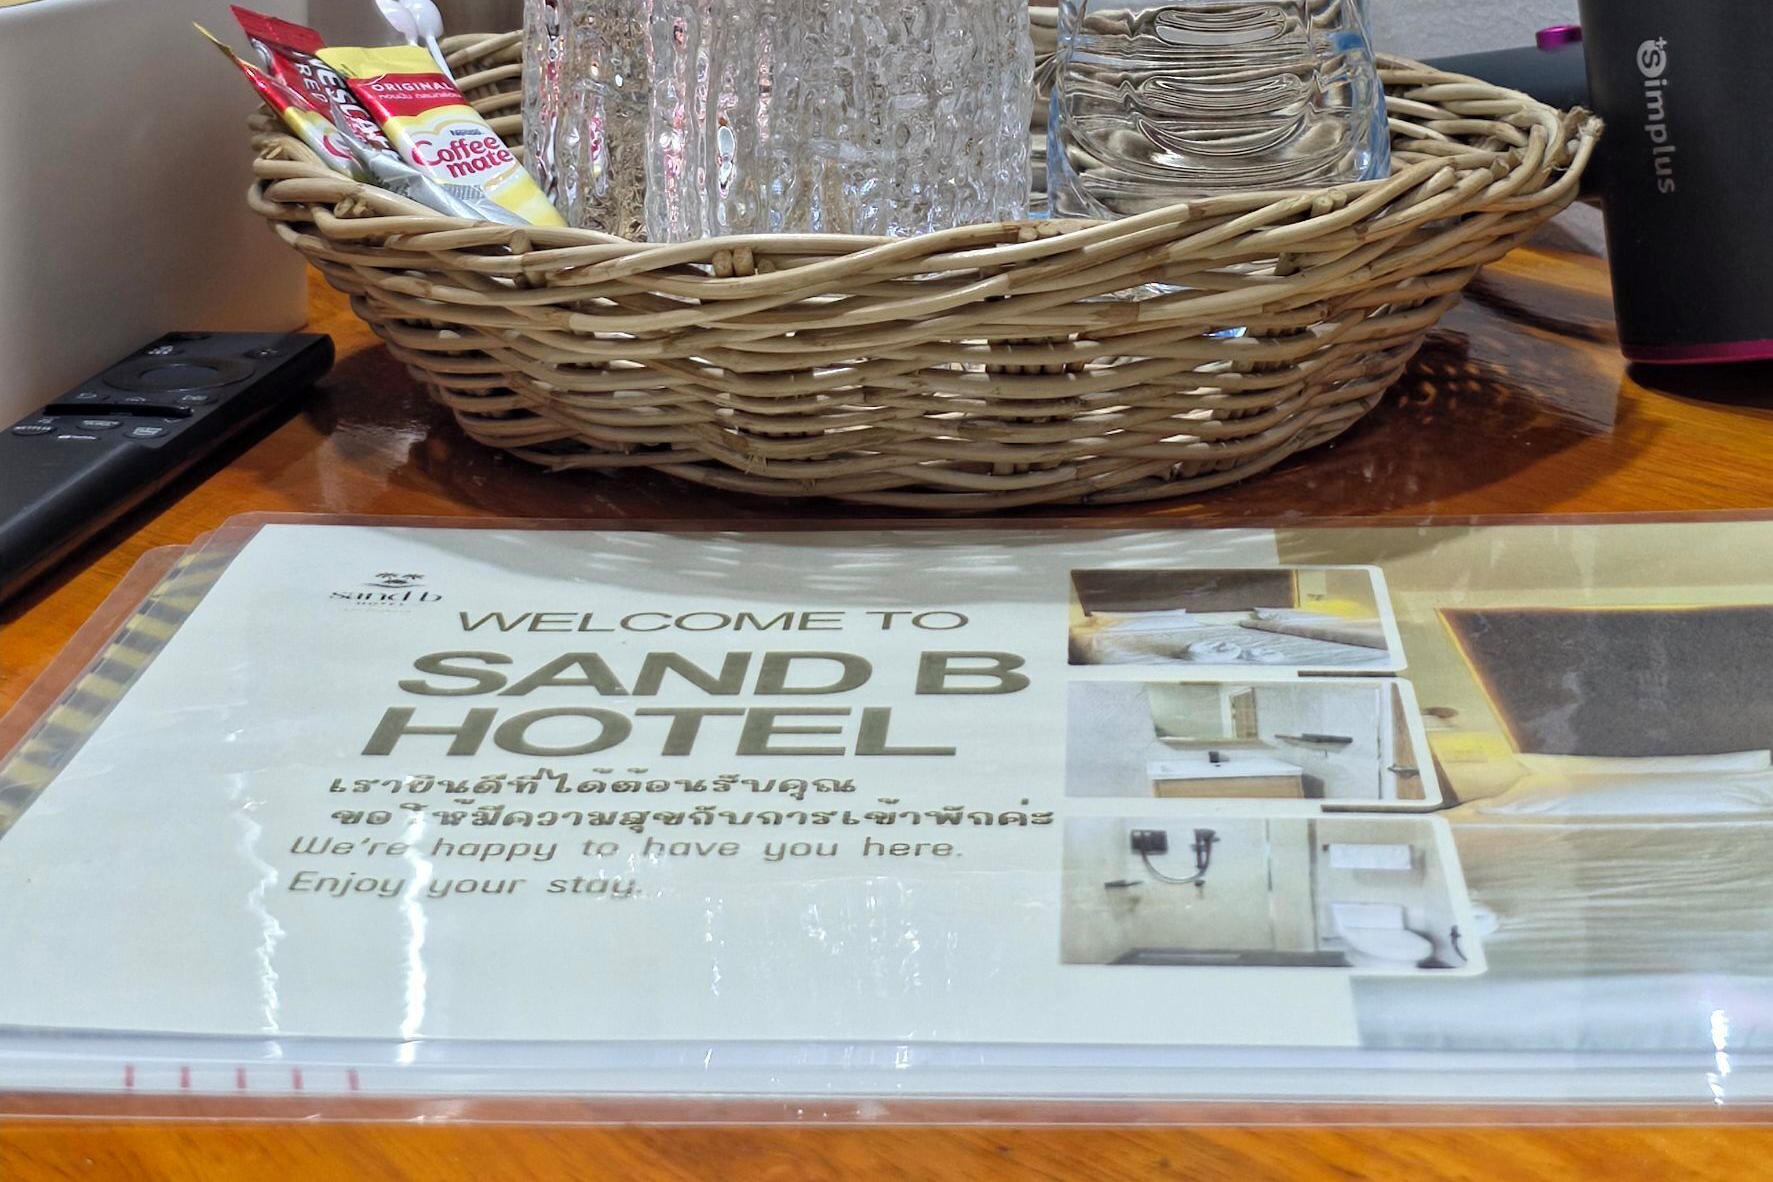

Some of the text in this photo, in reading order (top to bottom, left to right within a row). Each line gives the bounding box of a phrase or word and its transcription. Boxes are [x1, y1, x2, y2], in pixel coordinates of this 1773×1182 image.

[371, 82, 454, 92] ORIGINAL
[1636, 37, 1676, 194] Simplus
[411, 136, 500, 166] Coffee
[446, 148, 513, 178] mate
[459, 611, 969, 632] WELCOME TO
[398, 650, 1031, 696] SAND B
[361, 706, 957, 757] HOTEL
[290, 836, 964, 862] We're happy to have you here.
[288, 870, 642, 899] Enjoy your stay.
